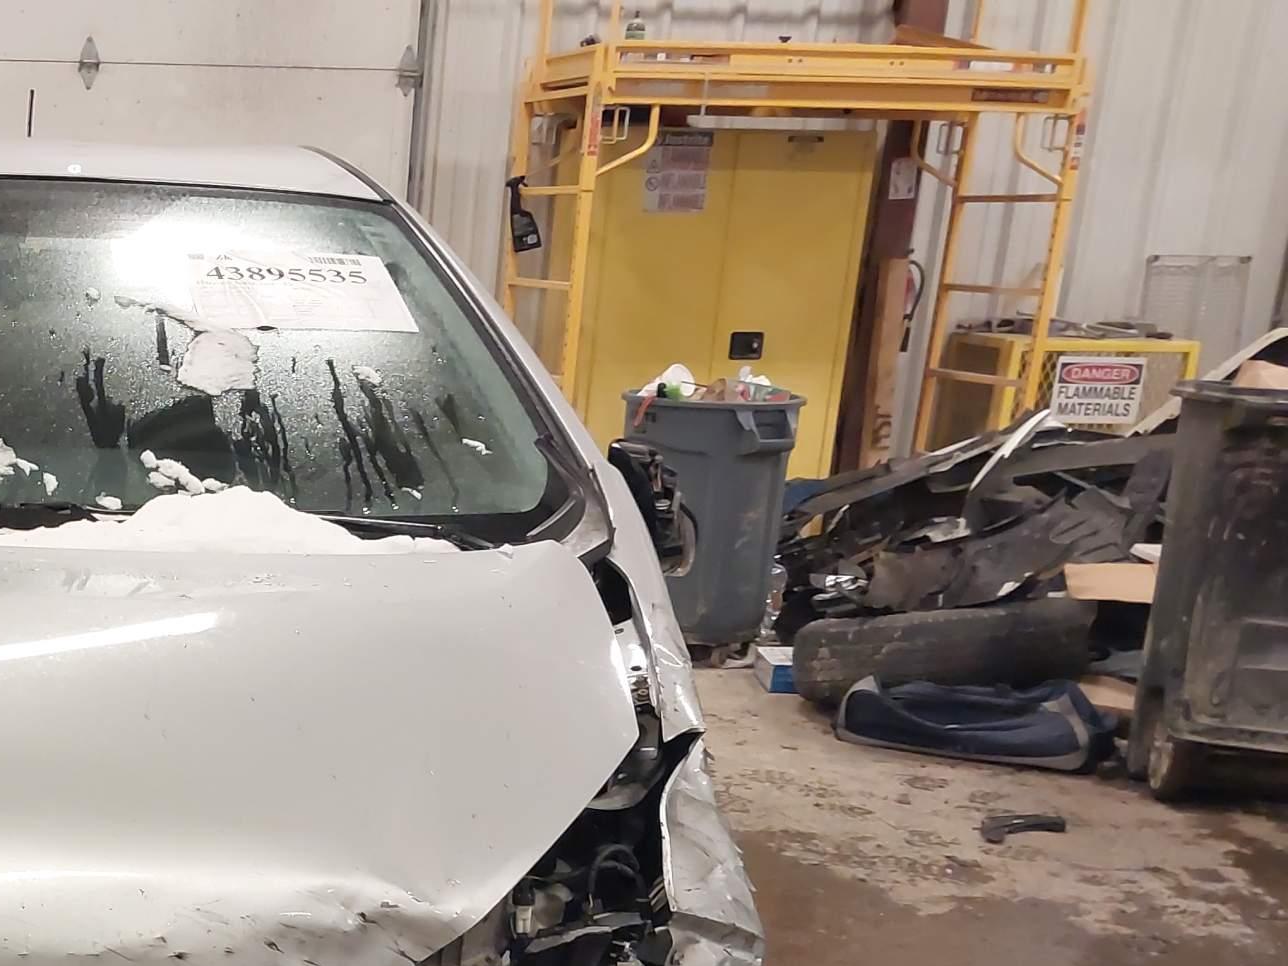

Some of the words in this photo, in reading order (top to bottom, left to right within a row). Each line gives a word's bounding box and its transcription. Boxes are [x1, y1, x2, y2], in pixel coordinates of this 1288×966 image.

[206, 265, 368, 285] 43895535
[1071, 367, 1131, 381] DANGER
[1057, 386, 1137, 401] FLAMMABLE
[1055, 402, 1132, 417] MATERIALS
